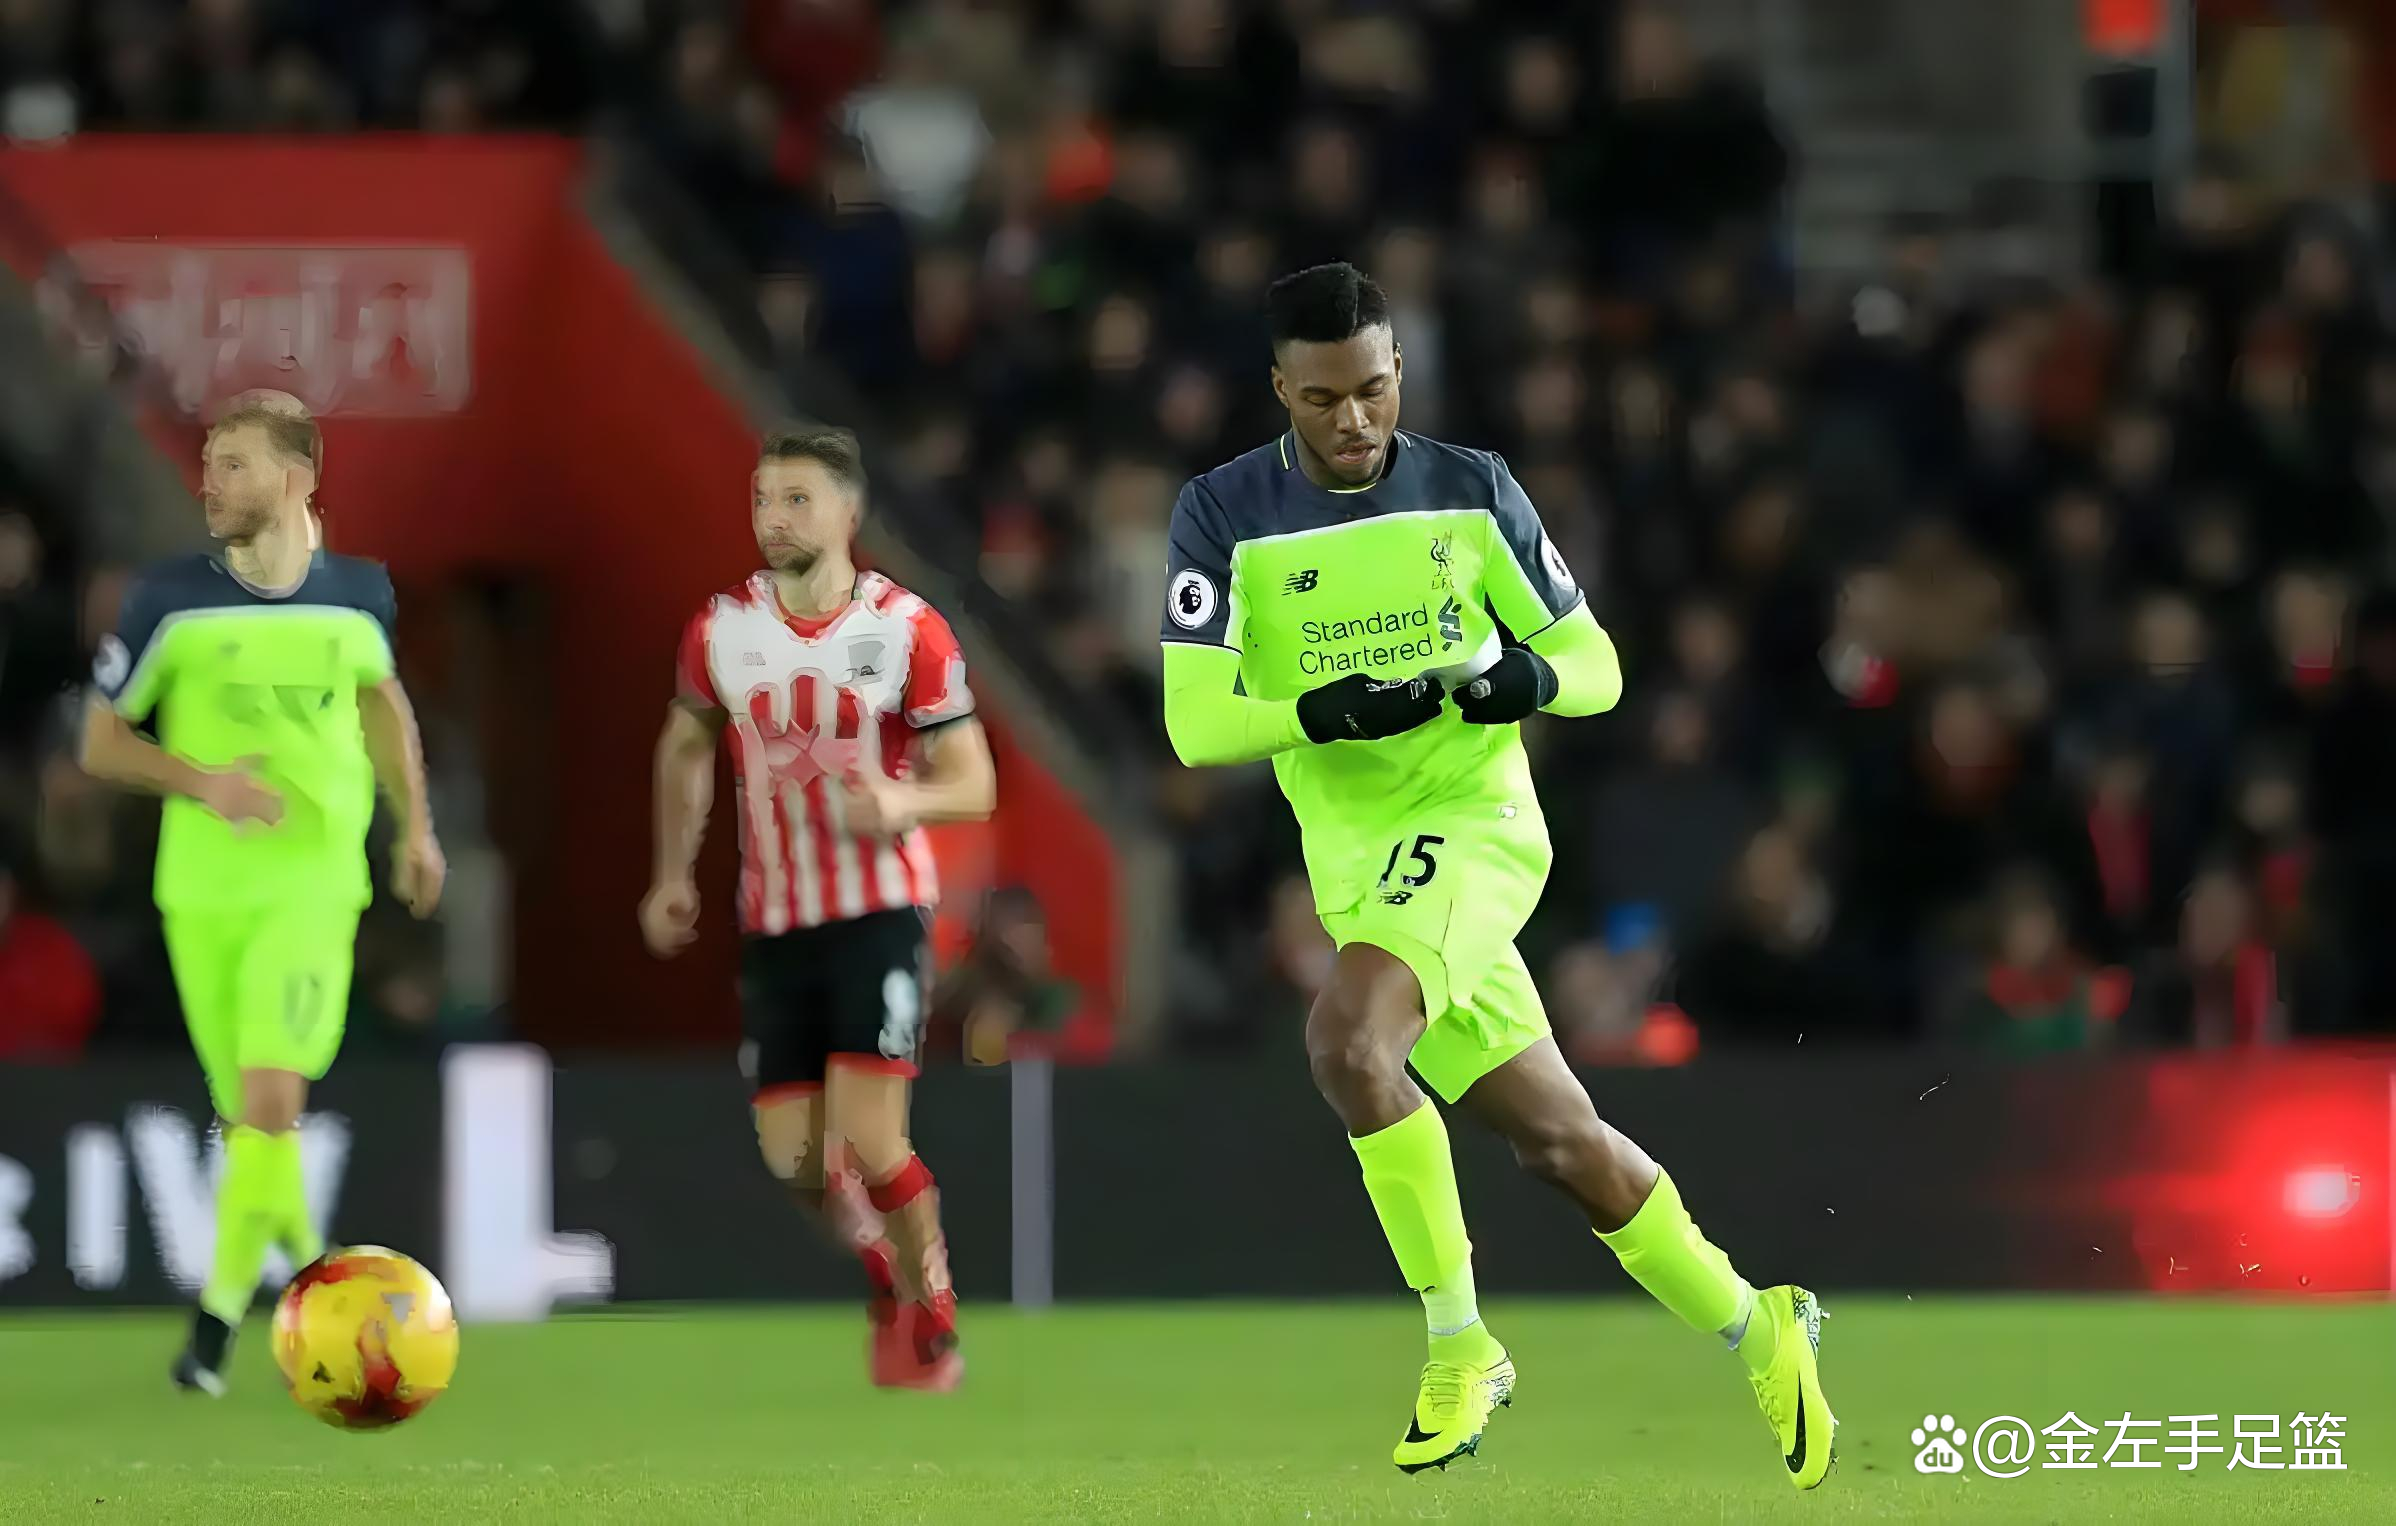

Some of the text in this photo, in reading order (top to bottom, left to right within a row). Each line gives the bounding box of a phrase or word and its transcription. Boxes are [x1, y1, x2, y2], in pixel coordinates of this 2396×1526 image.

[1301, 602, 1428, 643] Standard
[1299, 633, 1433, 675] Chartered
[1376, 834, 1445, 887] 15
